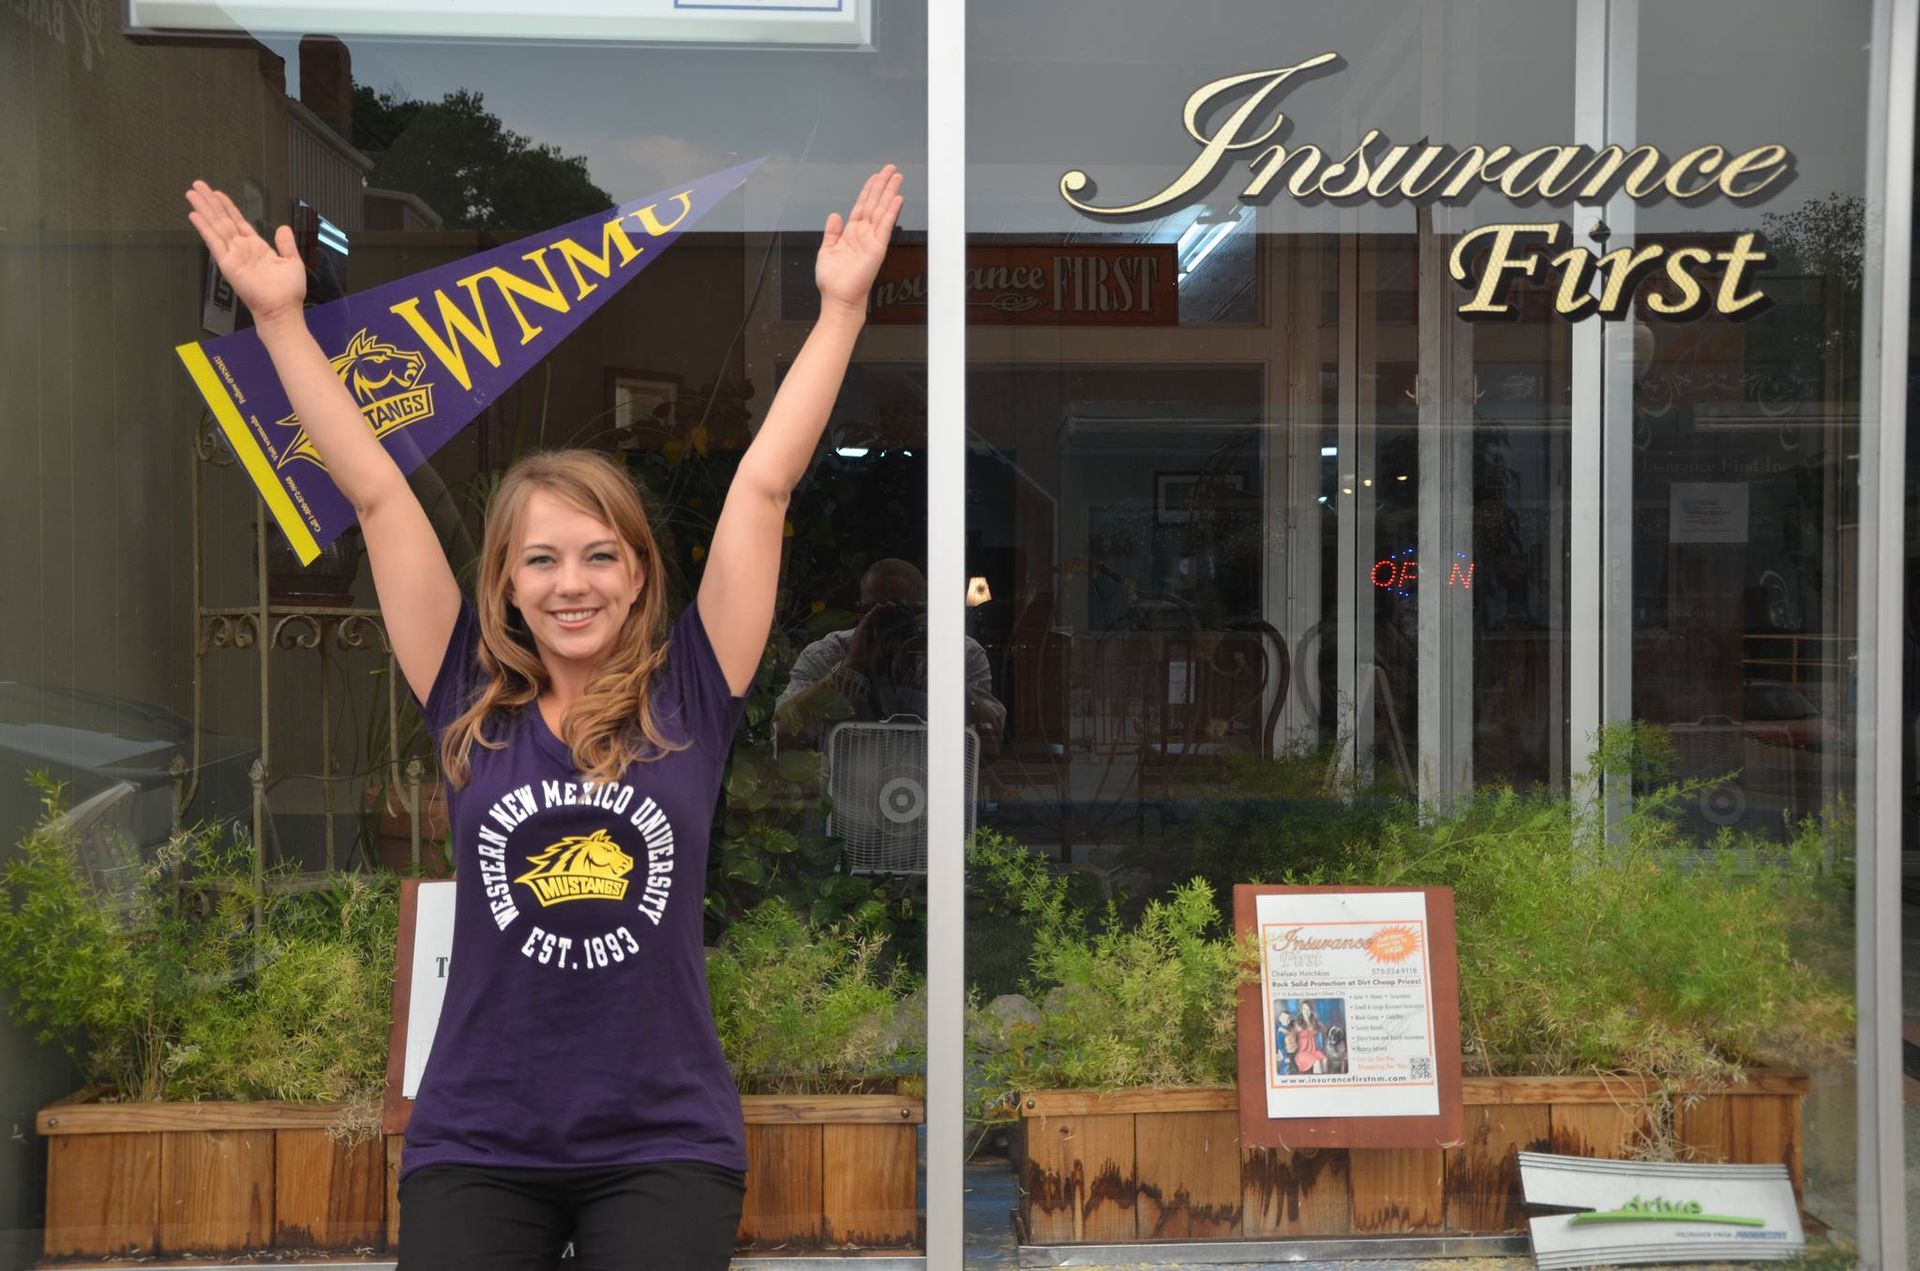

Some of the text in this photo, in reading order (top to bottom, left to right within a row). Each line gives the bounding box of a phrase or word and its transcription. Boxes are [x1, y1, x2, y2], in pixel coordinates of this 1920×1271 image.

[1060, 52, 1796, 214] Insurance
[1051, 256, 1159, 312] FIRST
[1448, 221, 1771, 320] First
[389, 189, 694, 391] WNMU
[362, 394, 425, 431] TANGS
[268, 446, 280, 463] Visit
[1370, 560, 1477, 590] OPN
[478, 779, 675, 932] WESTERN NEW MEXICO UNIVERSITY
[535, 876, 623, 900] MUSTANGS
[521, 926, 640, 970] EST. 1893
[1272, 927, 1373, 951] Insurance
[1272, 980, 1289, 988] Rock
[1291, 980, 1308, 988] Solid
[1310, 979, 1346, 987] Protection
[1372, 978, 1396, 988] Cheap
[1280, 1074, 1407, 1084] www.insurancefirstnm.com
[1621, 1194, 1703, 1215] drive
